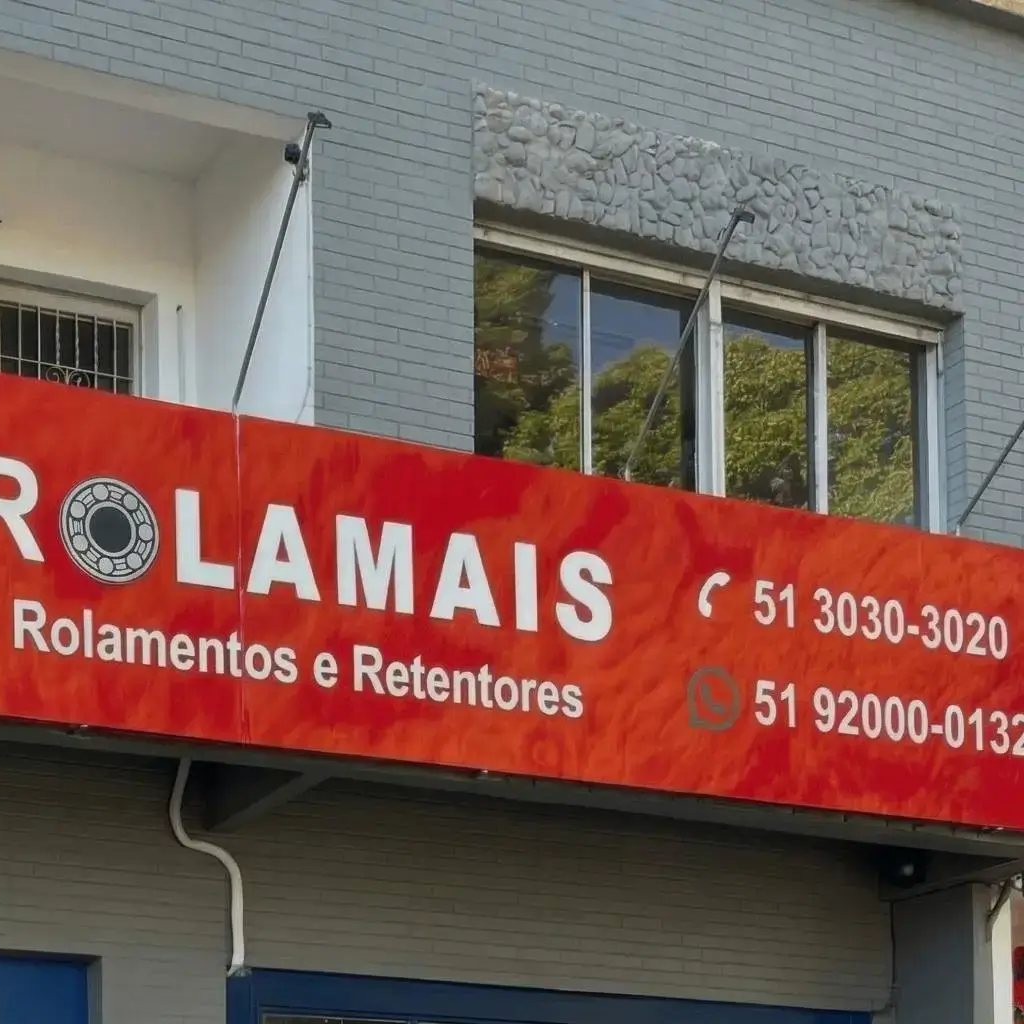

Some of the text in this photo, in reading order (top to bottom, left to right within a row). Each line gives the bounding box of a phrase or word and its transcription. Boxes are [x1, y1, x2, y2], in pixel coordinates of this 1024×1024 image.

[13, 598, 584, 719] Rolamentos e Retentores
[754, 579, 1008, 660] 51 3030-3020
[754, 679, 1024, 757] 51 92000-0132
